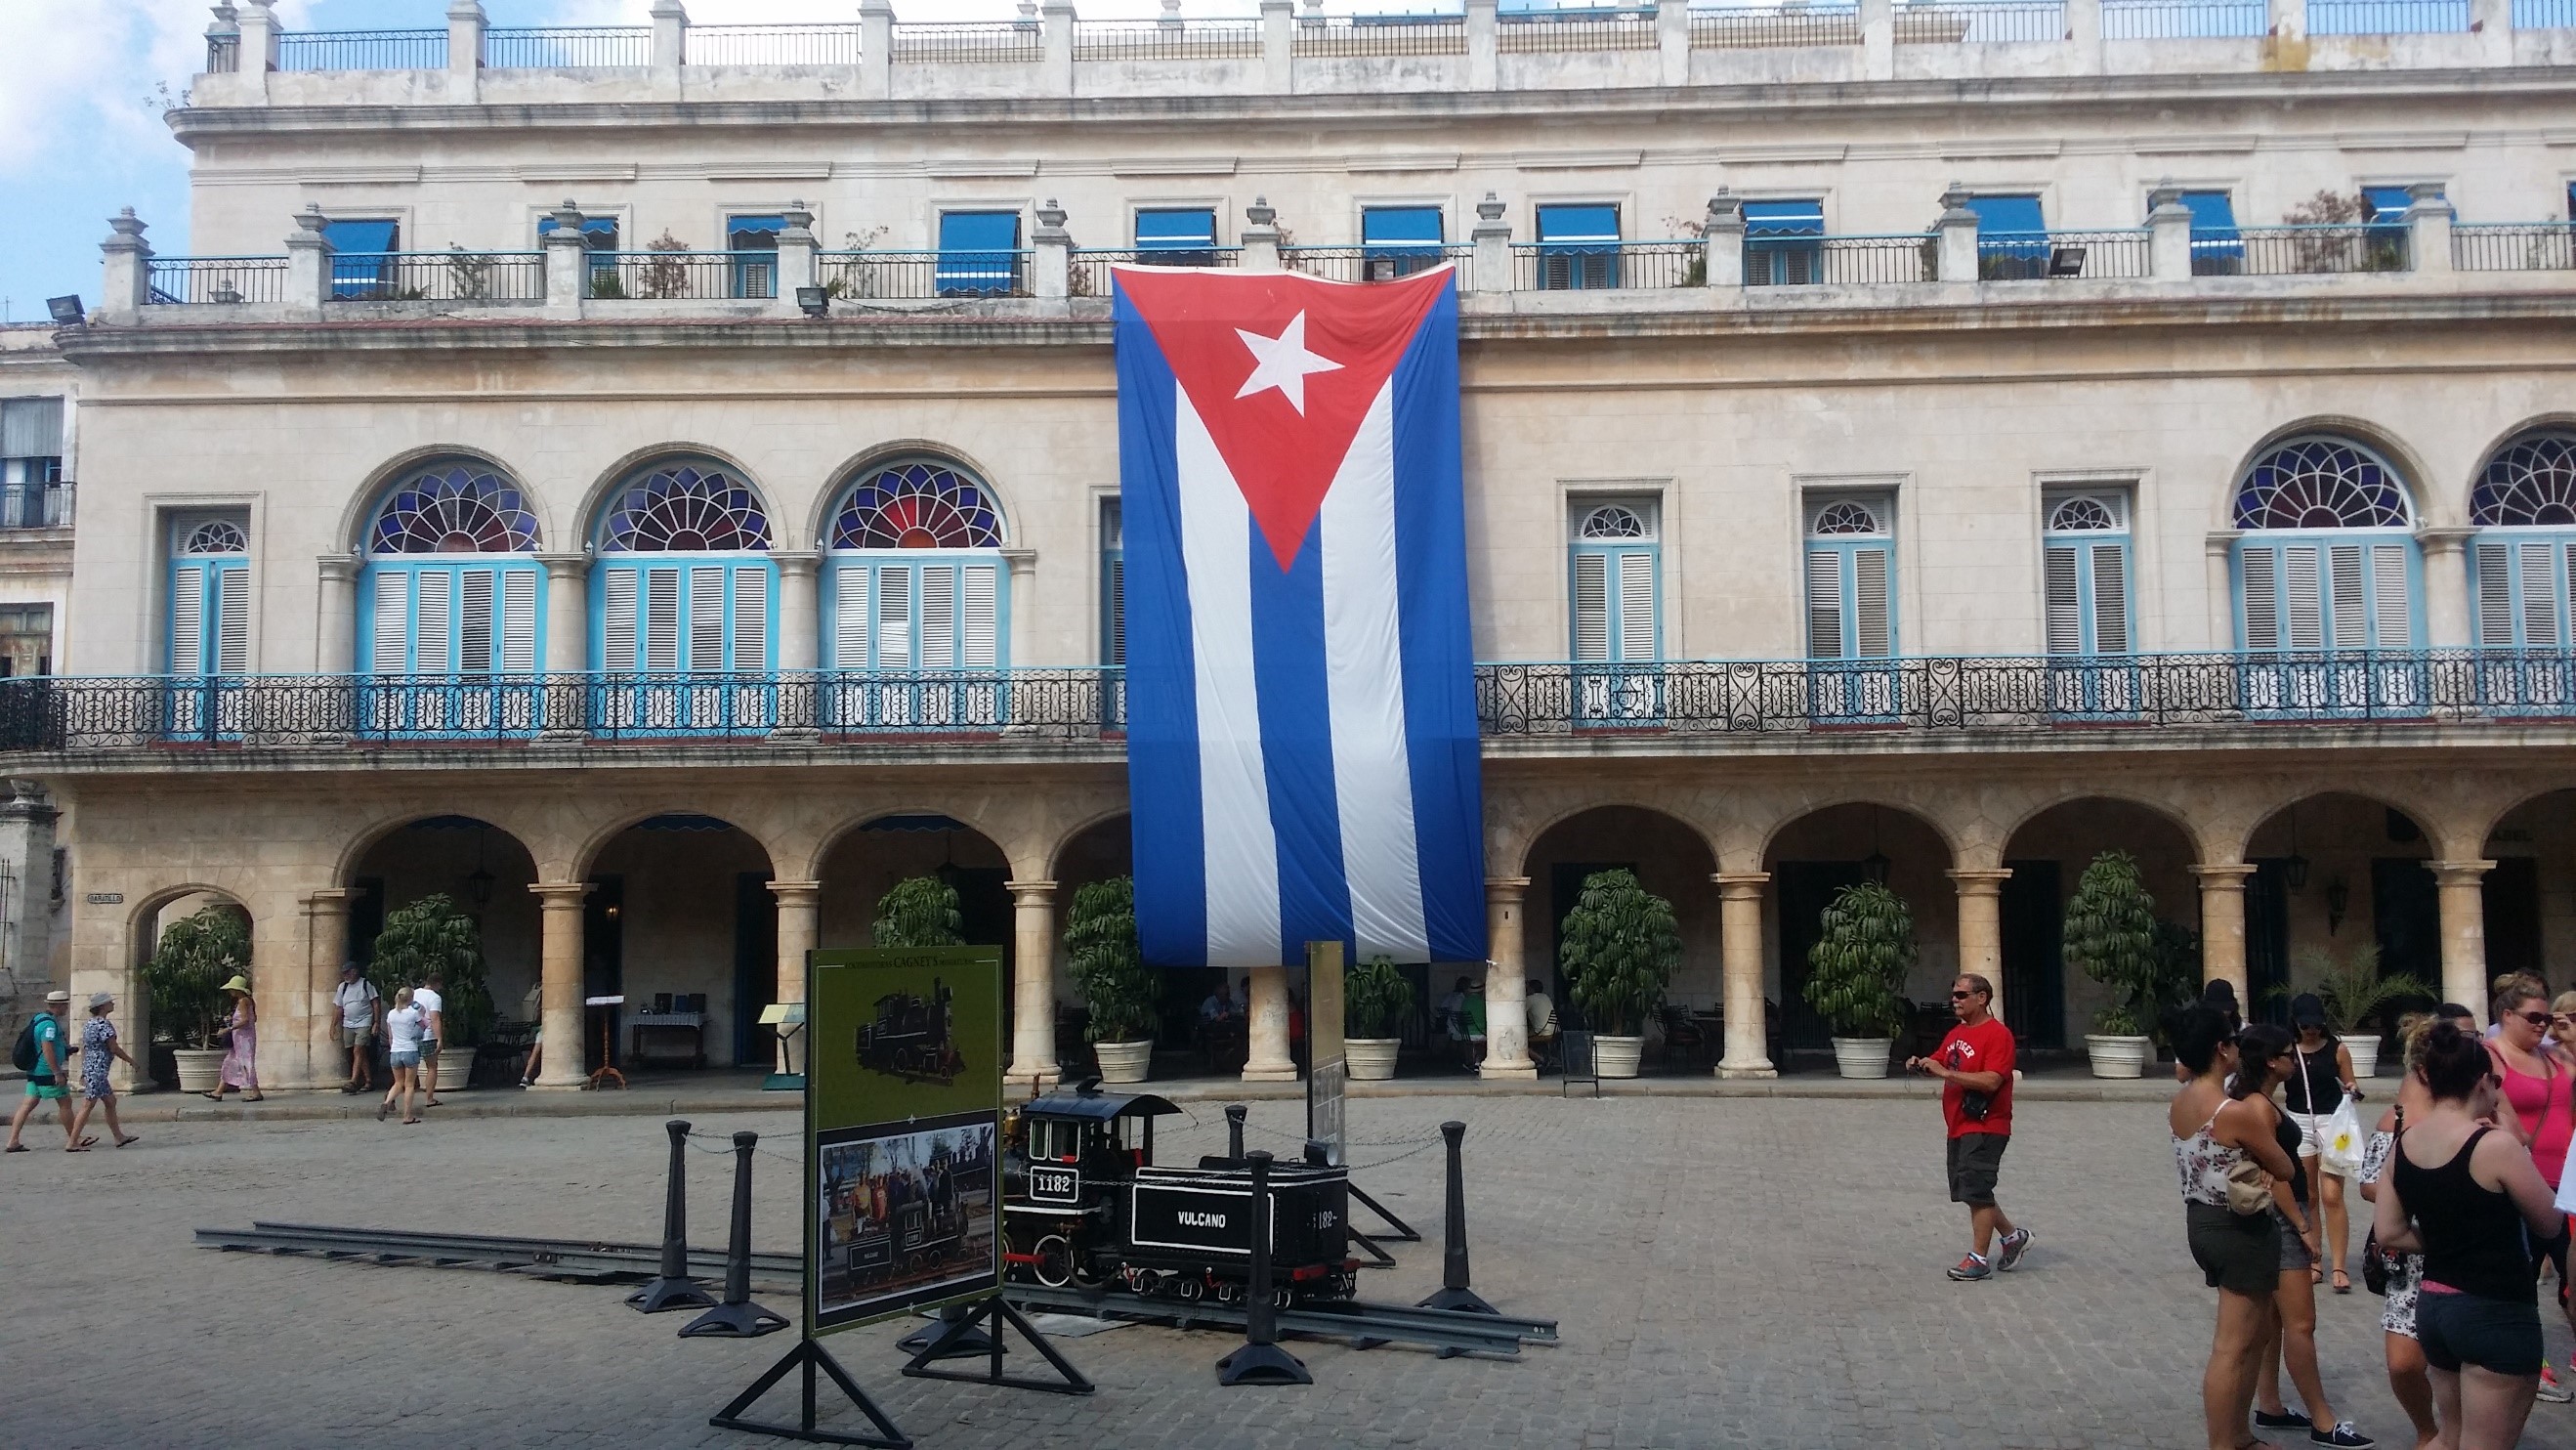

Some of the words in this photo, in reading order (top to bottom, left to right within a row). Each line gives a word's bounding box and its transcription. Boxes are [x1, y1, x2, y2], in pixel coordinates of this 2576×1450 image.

[894, 956, 938, 968] CAGNEY'S
[1037, 1173, 1071, 1193] 1182
[1177, 1211, 1226, 1229] VULCANO
